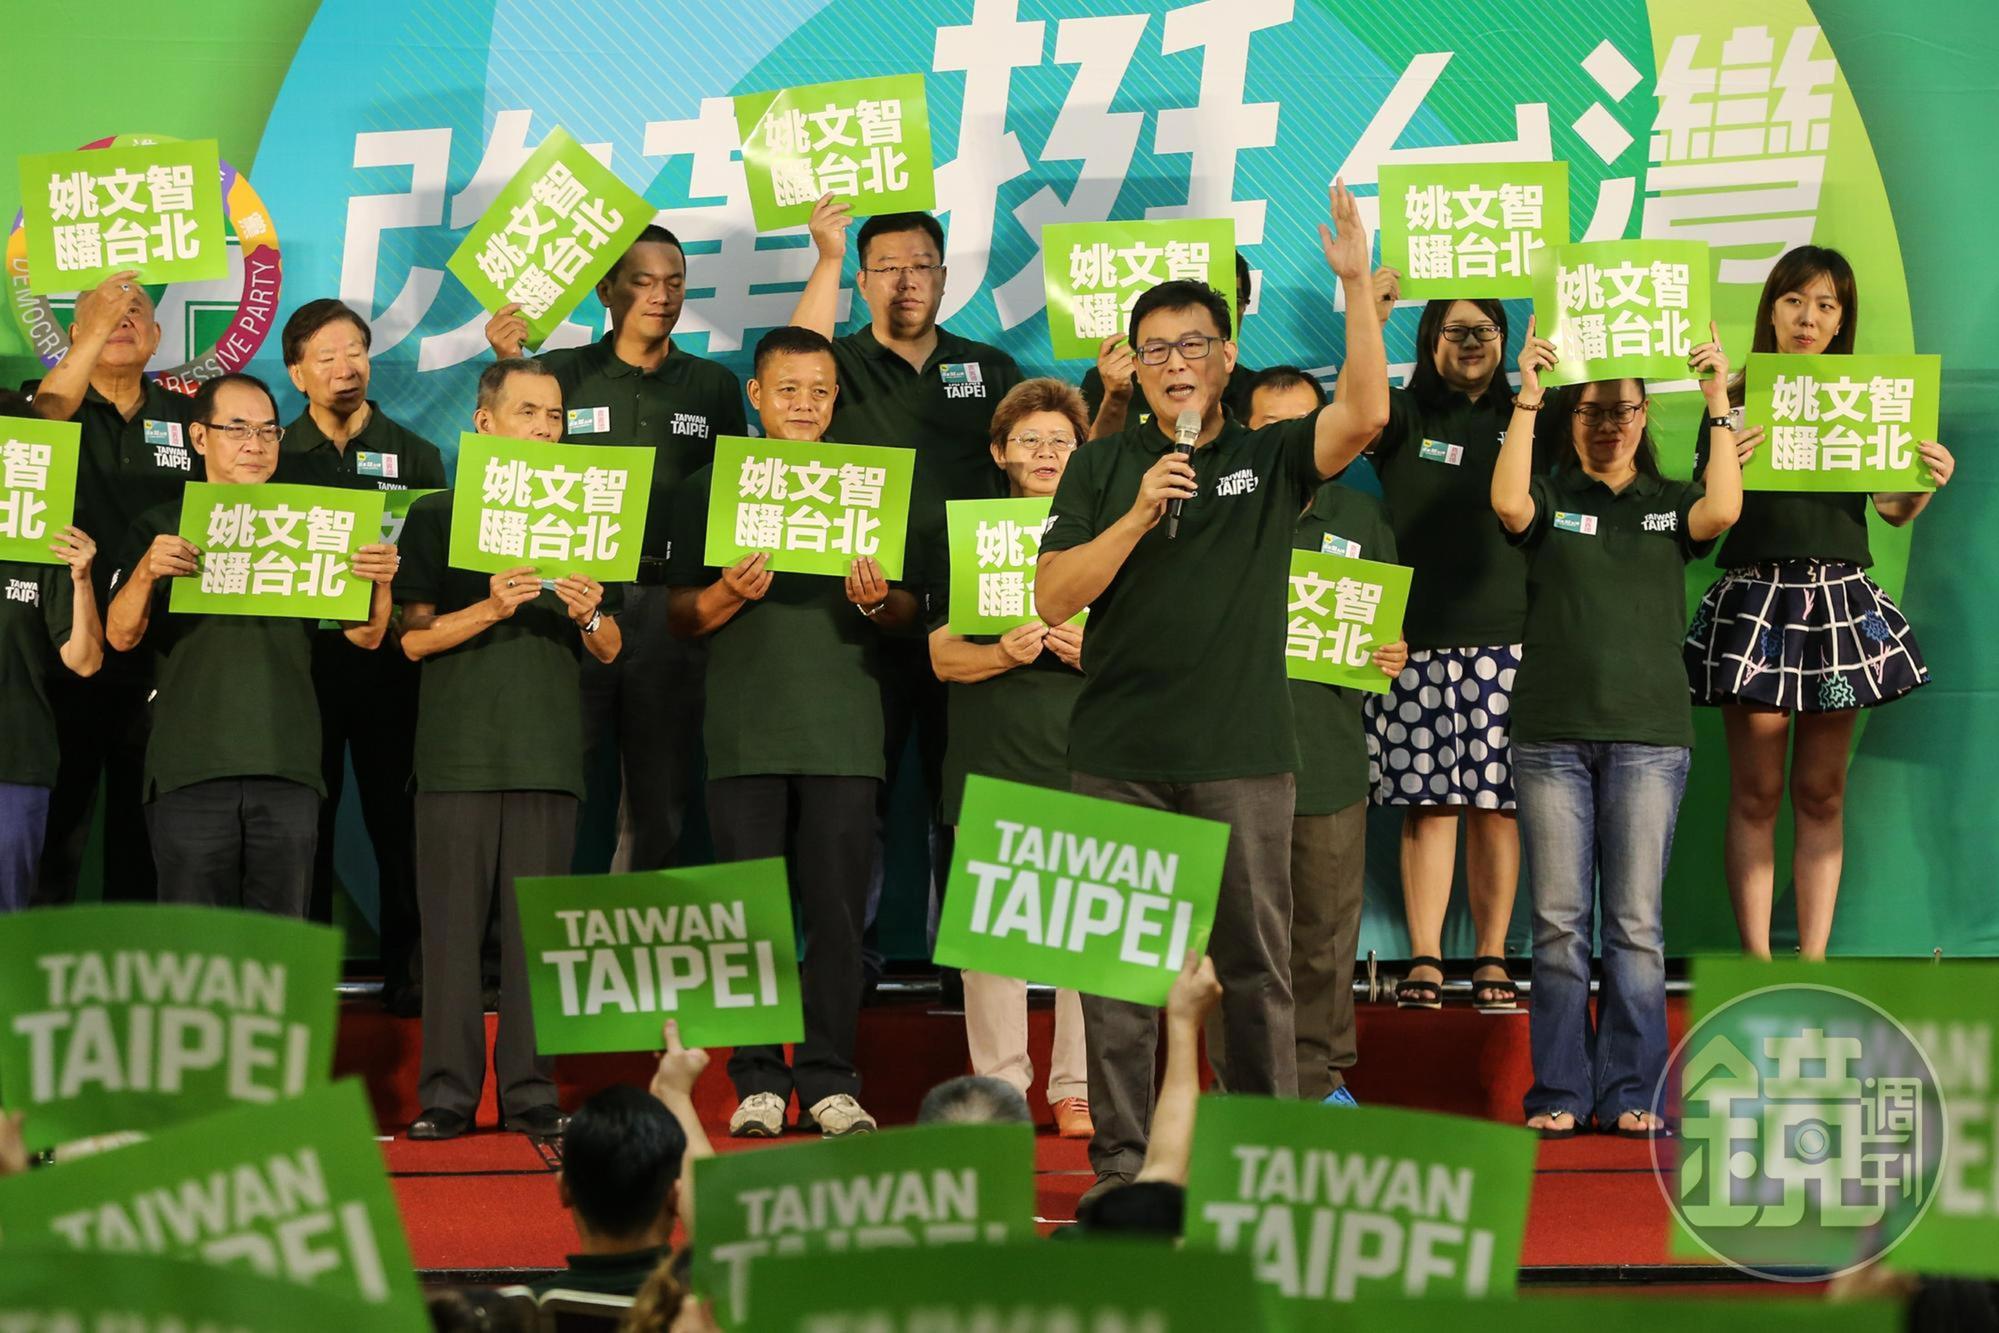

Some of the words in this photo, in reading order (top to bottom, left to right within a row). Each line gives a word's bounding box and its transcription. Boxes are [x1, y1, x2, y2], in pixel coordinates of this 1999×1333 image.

[765, 98, 904, 155] 姚文智
[48, 164, 194, 222] 姚文智
[1404, 183, 1544, 231] 姚文智
[475, 160, 589, 290] 姚文智
[1069, 240, 1210, 290] 姚文智
[1556, 260, 1690, 310] 姚文智
[239, 260, 276, 336] PARTY
[674, 412, 707, 424] TAIWAN
[944, 384, 987, 399] TAIPEI
[1772, 375, 1915, 423] 姚文智
[156, 445, 188, 457] TAIWAN
[670, 420, 709, 439] TAIPEI
[153, 452, 191, 471] TAIPEI
[482, 456, 628, 514] 姚文智
[738, 455, 887, 509] 姚文智
[1216, 476, 1259, 496] TAIPEI
[1218, 469, 1253, 485] TAIWAN
[206, 503, 355, 555] 姚文智
[1641, 518, 1679, 531] TAIPE
[995, 820, 1179, 895] TAIWAN
[555, 900, 748, 947] TAIWAN
[967, 860, 1193, 972] TAIPEI
[38, 950, 287, 1015] TAIWAN
[541, 940, 779, 1016] TAIPEI
[12, 1005, 310, 1104] TAIPEI
[51, 1147, 330, 1254] TAIWAN
[738, 1168, 979, 1237] TAIWAN
[1233, 1145, 1474, 1223] TAIWAN
